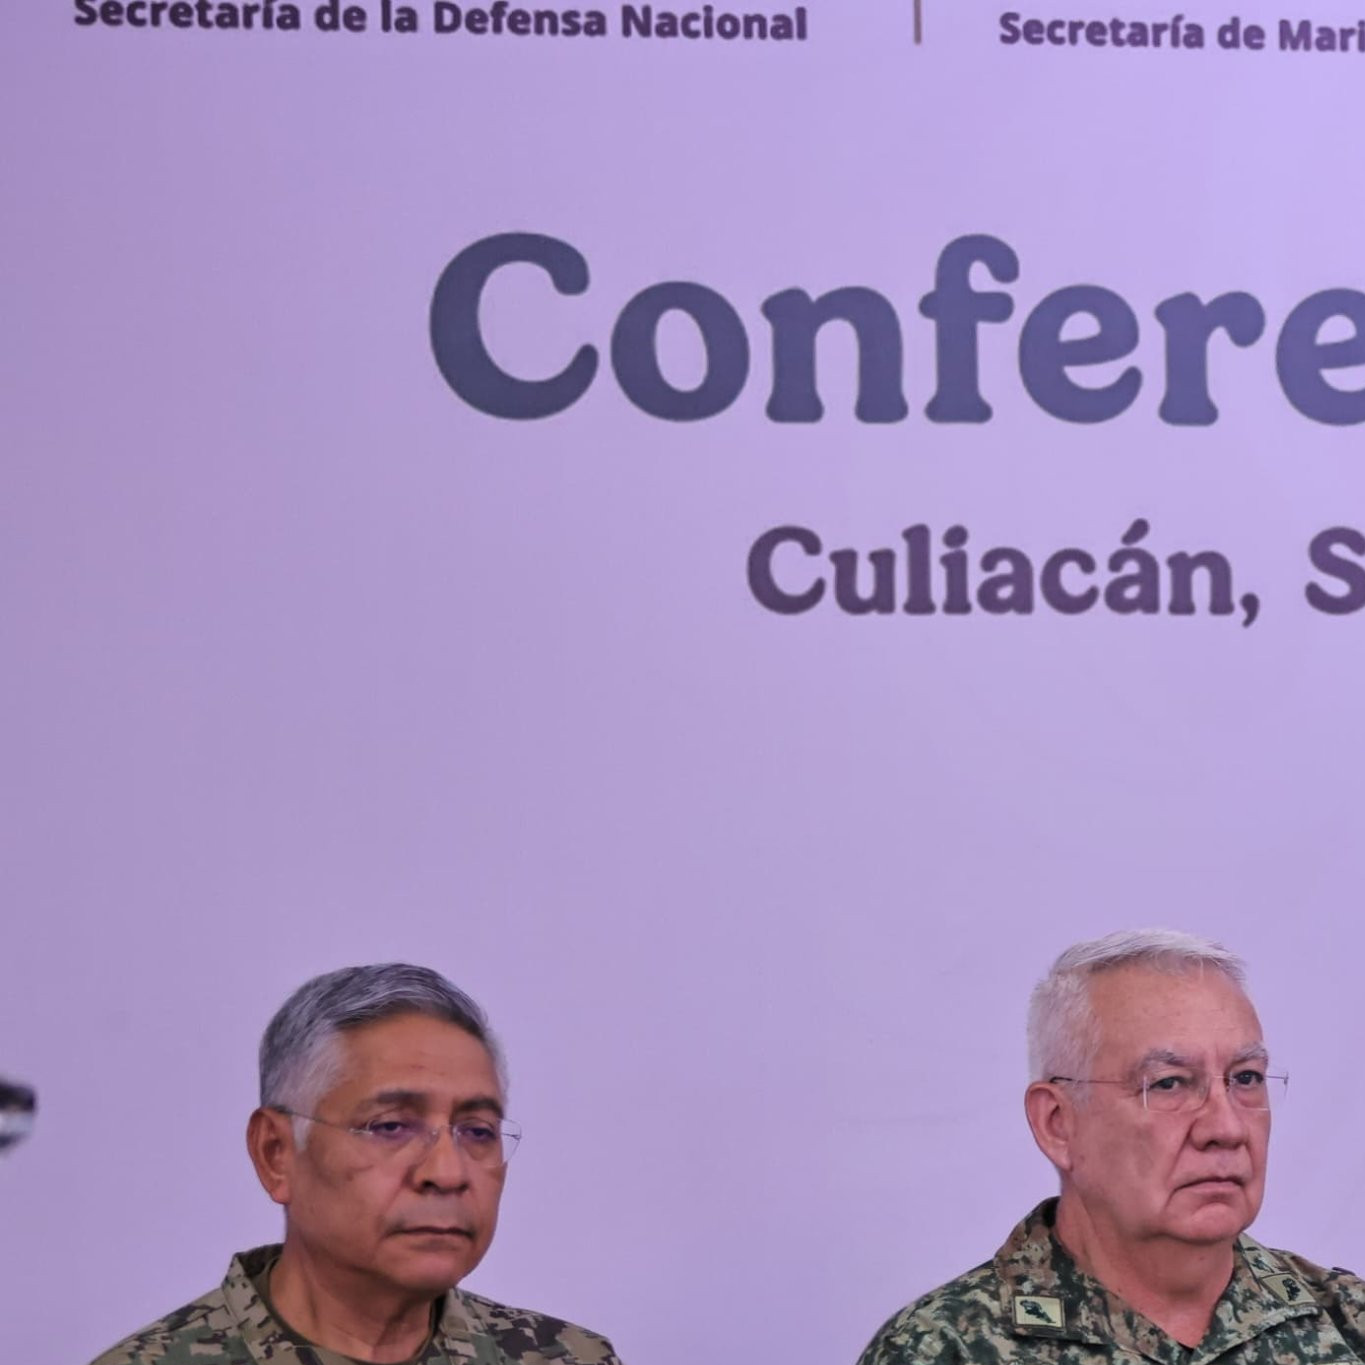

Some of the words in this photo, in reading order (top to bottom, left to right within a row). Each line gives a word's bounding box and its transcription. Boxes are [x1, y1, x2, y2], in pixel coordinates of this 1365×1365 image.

[73, 0, 302, 31] Secretaría
[314, 0, 367, 33] de
[381, 0, 418, 33] la
[434, 0, 607, 37] Defensa
[622, 4, 807, 40] Nacional
[1000, 11, 1204, 49] Secretaría
[1217, 15, 1265, 50] de
[747, 517, 1260, 628] Culiacán,
